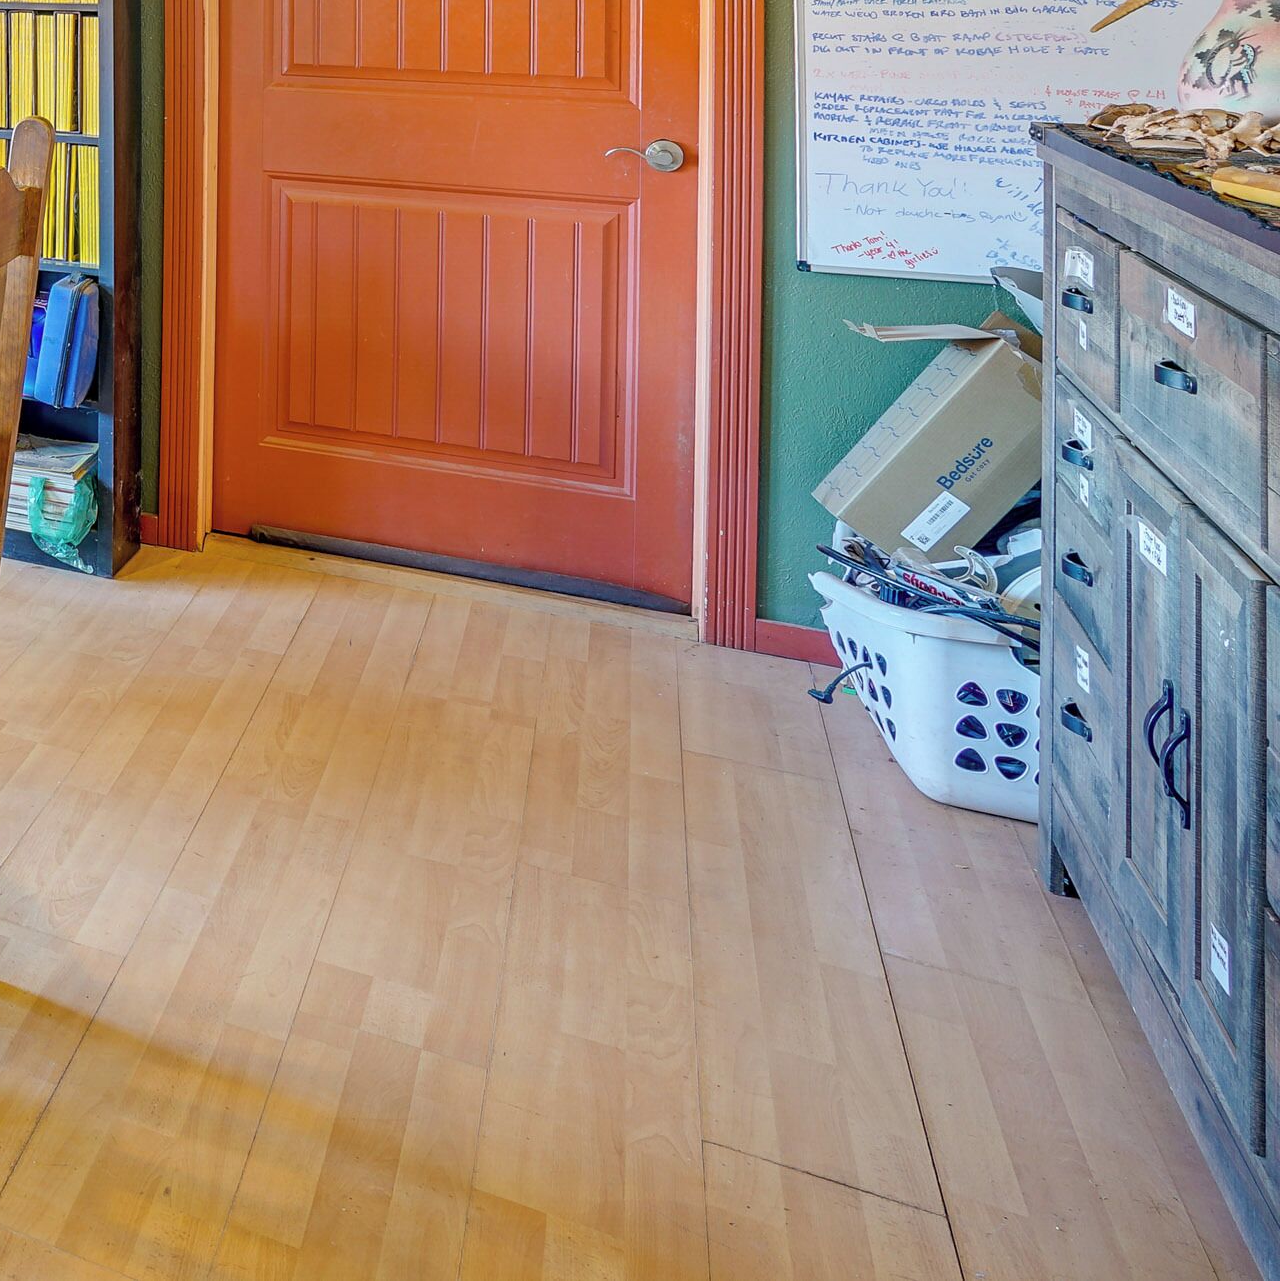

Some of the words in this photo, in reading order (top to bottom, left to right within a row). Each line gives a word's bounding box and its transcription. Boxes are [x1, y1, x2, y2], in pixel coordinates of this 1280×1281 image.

[812, 10, 842, 18] WATER
[989, 8, 1000, 16] IN
[1032, 5, 1077, 15] GARAGE
[851, 32, 887, 43] STAIRS
[952, 32, 990, 43] RAMP
[812, 45, 831, 54] DIG
[835, 45, 861, 54] OUT
[865, 46, 882, 54] IN
[888, 46, 929, 56] FRONT
[934, 46, 951, 56] OF
[1007, 46, 1050, 55] HOLE
[814, 92, 855, 101] KAYAK
[813, 102, 849, 111] ORDER
[933, 109, 963, 118] PART
[813, 132, 866, 144] KITCHEN
[814, 172, 909, 198] Thank
[863, 231, 888, 245] Tom!
[936, 437, 993, 490] Bedsure
[965, 472, 977, 483] Get
[977, 459, 991, 472] cozy
